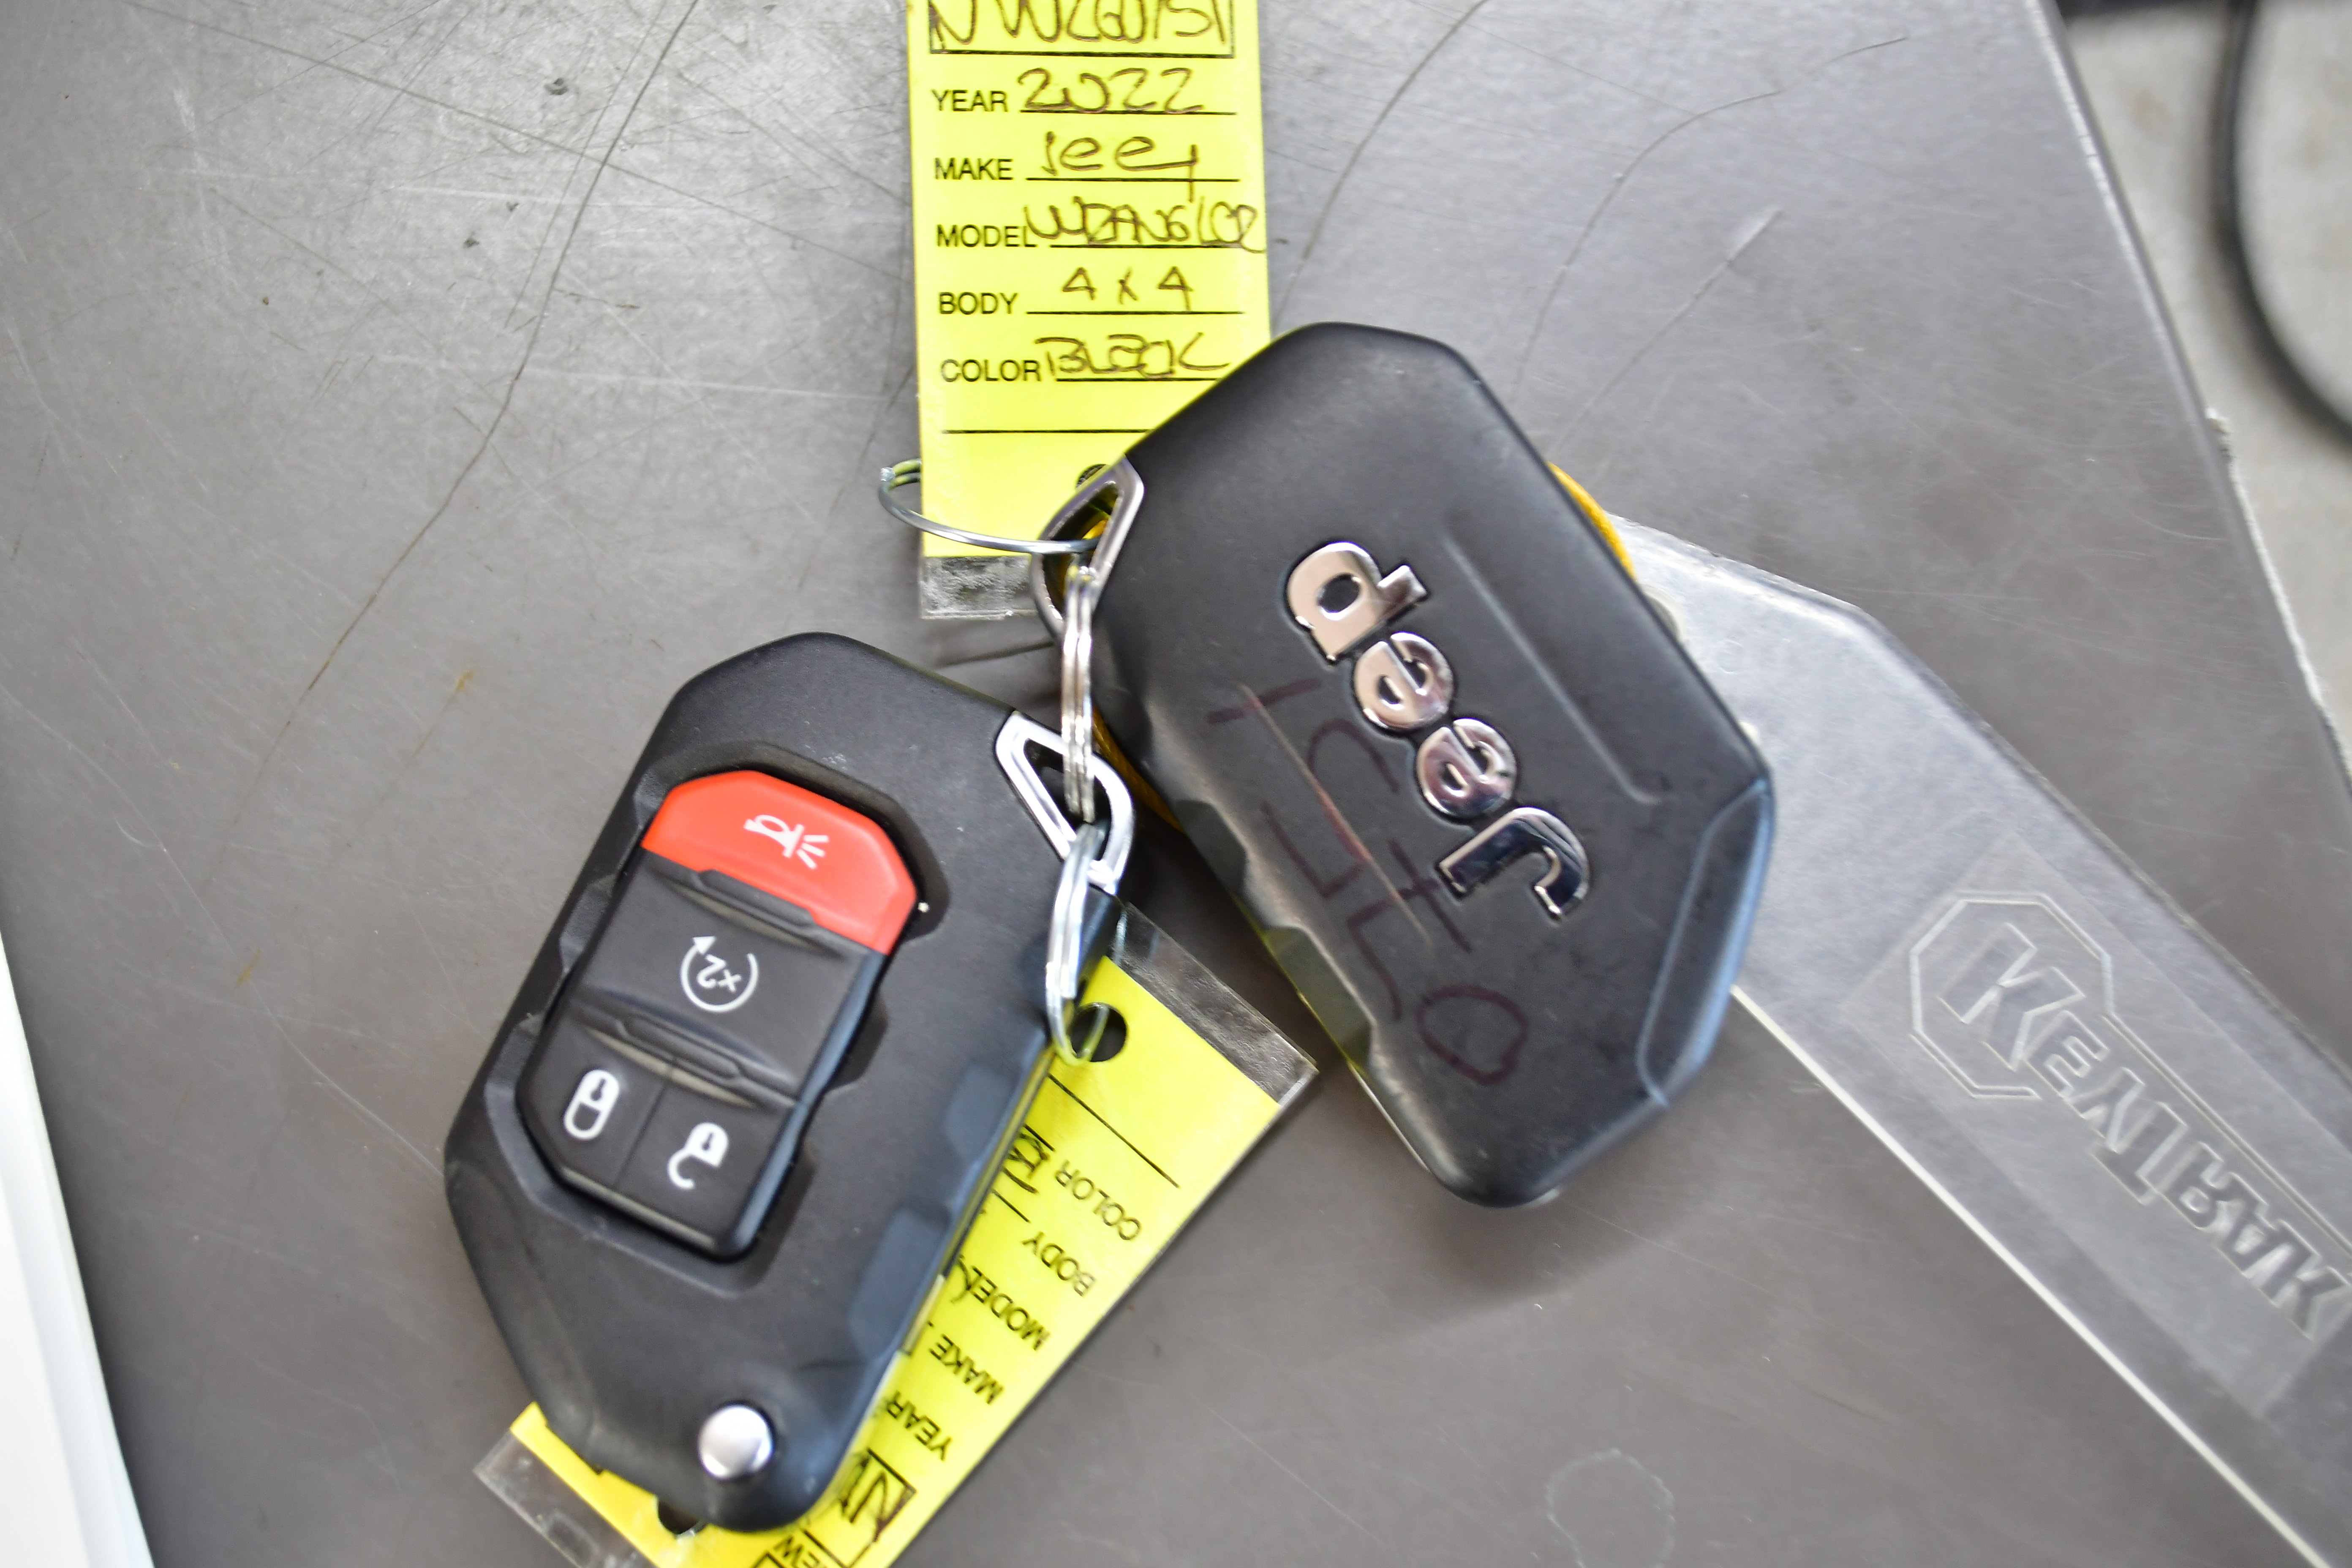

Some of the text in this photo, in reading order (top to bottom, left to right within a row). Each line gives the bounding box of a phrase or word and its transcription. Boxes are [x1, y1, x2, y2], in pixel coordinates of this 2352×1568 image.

[932, 90, 1008, 112] YEAR
[1018, 68, 1204, 114] 2022
[935, 158, 1014, 180] MAKE
[936, 225, 1037, 248] MODEL
[939, 292, 1018, 315] BODY
[941, 359, 1041, 382] COLOR
[1285, 540, 1590, 920] Jeep
[1054, 1160, 1141, 1241] COLOR
[1022, 1230, 1097, 1297] BODY
[969, 1265, 1050, 1350] MODEL
[930, 1334, 1004, 1405] MAKE
[887, 1391, 953, 1461] YEAR
